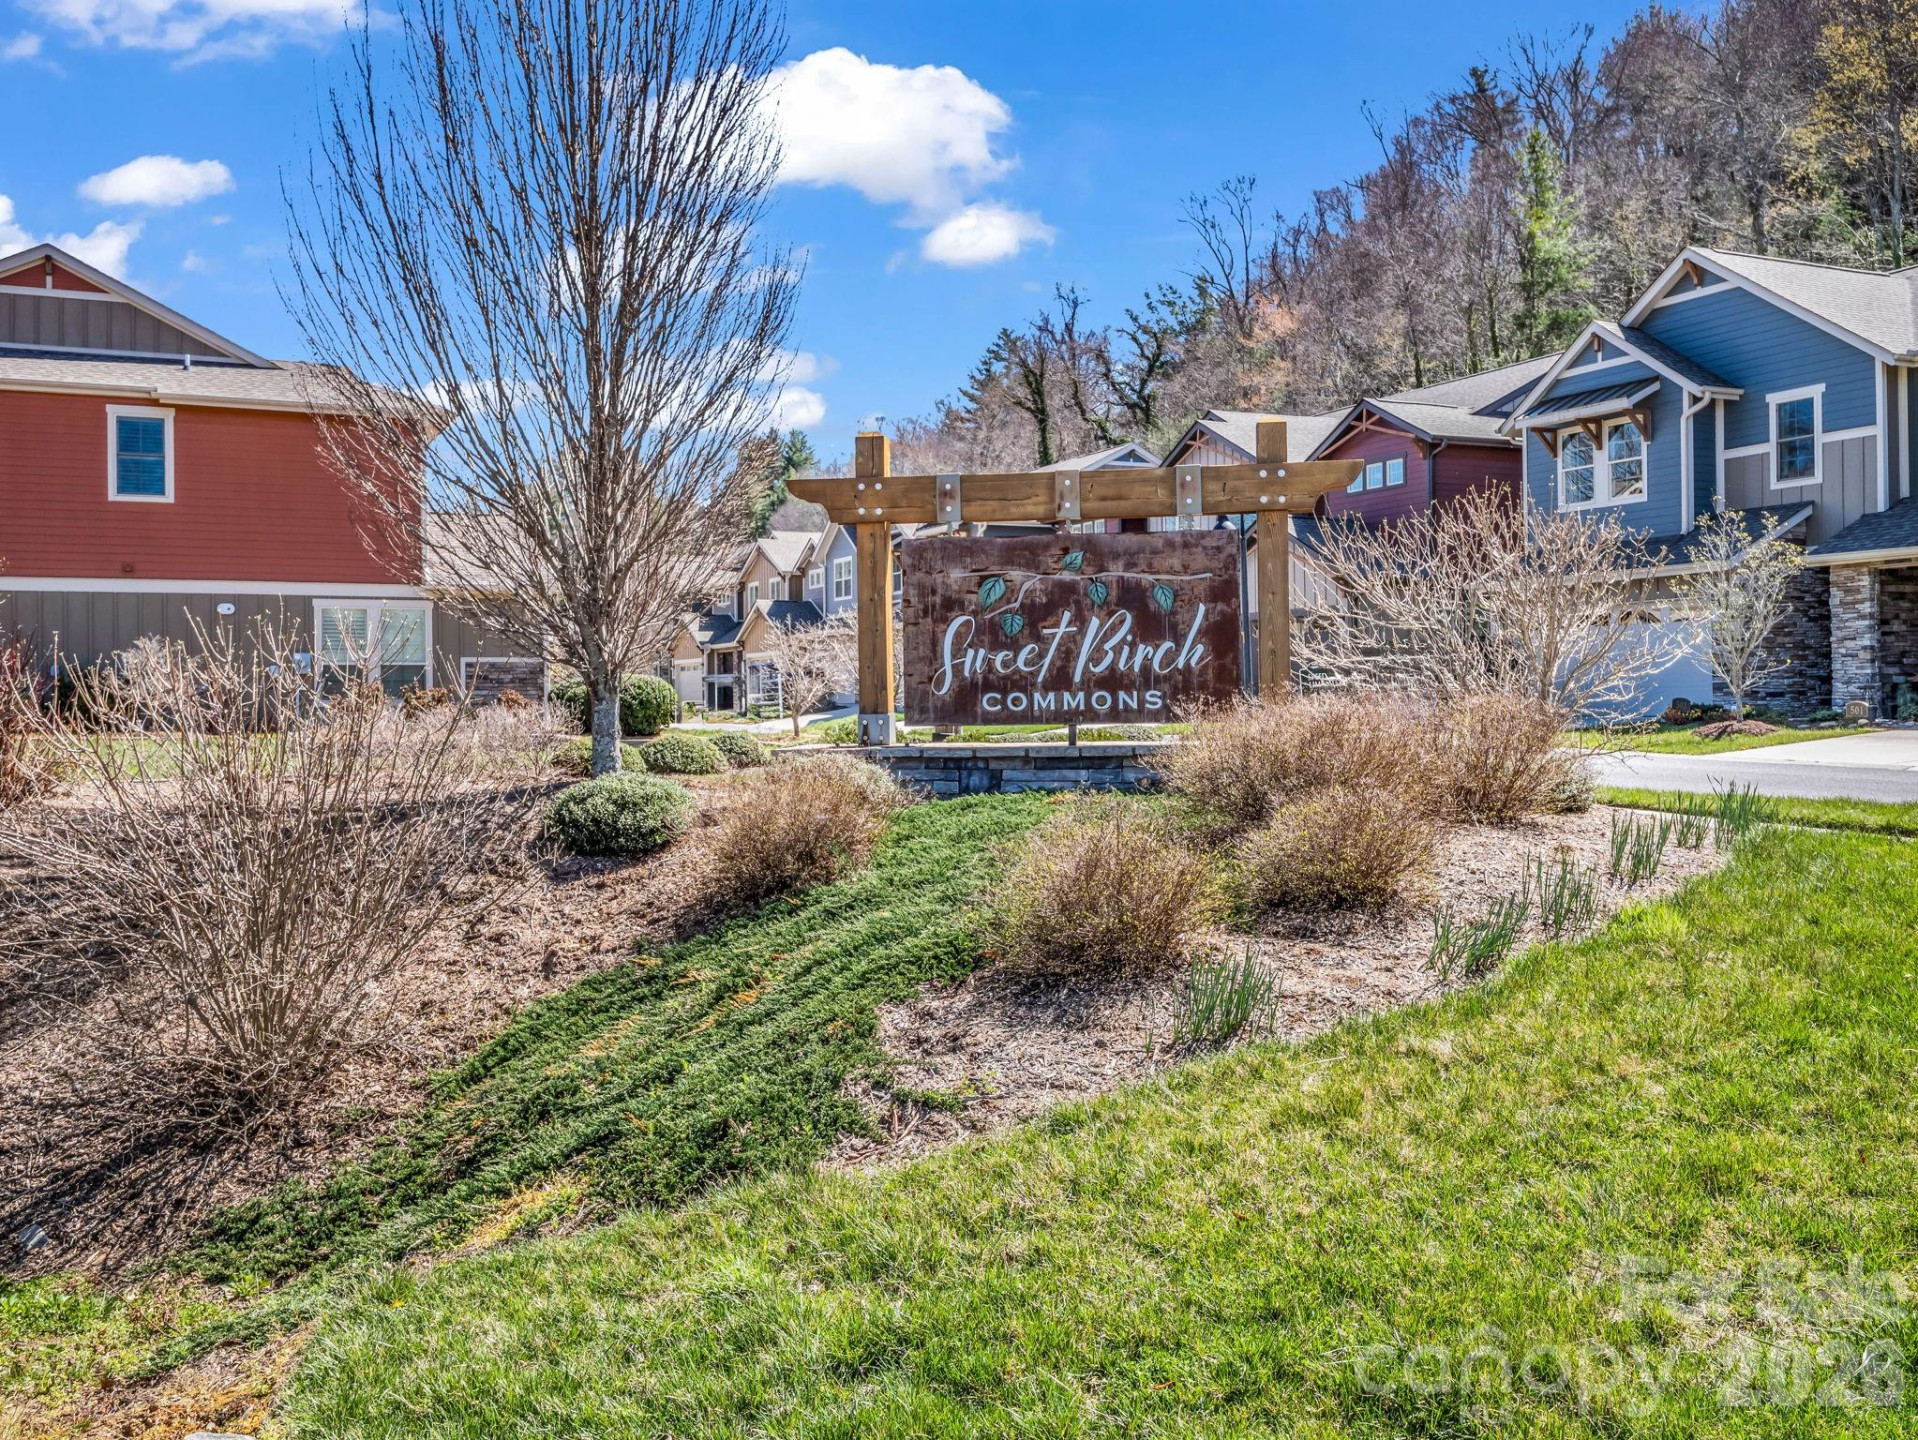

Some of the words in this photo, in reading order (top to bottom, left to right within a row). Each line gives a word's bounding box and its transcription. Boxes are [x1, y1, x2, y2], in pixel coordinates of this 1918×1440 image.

[931, 609, 1078, 695] Sweet
[1074, 602, 1212, 683] Birch
[981, 689, 1163, 711] COMMONS
[1850, 705, 1863, 715] 501
